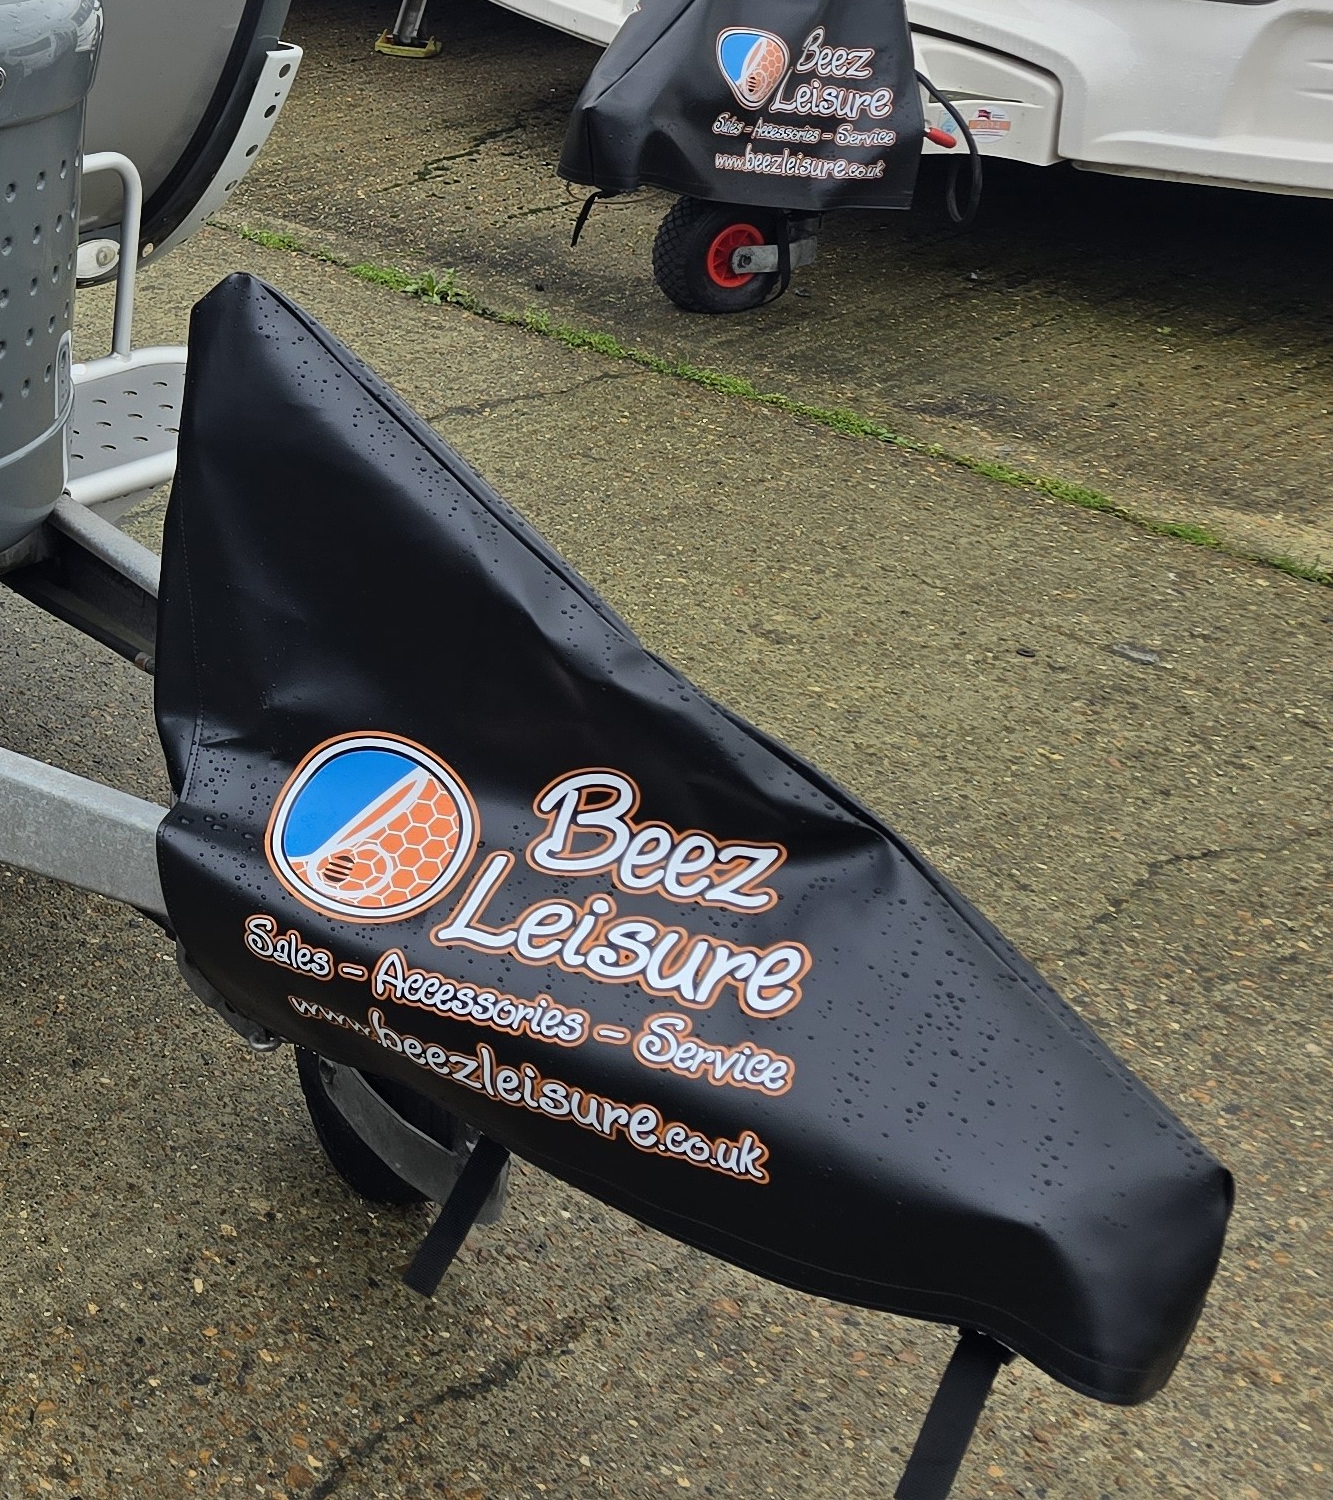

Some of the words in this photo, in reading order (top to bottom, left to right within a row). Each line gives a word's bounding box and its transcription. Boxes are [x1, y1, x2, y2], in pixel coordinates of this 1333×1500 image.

[770, 67, 892, 118] Leisure
[796, 27, 874, 78] Beez
[712, 112, 744, 136] Sales
[751, 117, 821, 143] Accessories
[836, 124, 896, 146] Service
[715, 143, 885, 178] www.beezleisure.co.uk
[528, 769, 785, 911] Beez
[433, 853, 807, 1013] Leisure
[246, 917, 332, 978] Sales
[373, 952, 588, 1044] Accessories
[637, 1015, 792, 1094] Service
[289, 995, 769, 1182] www.beezleisure.co.uk
